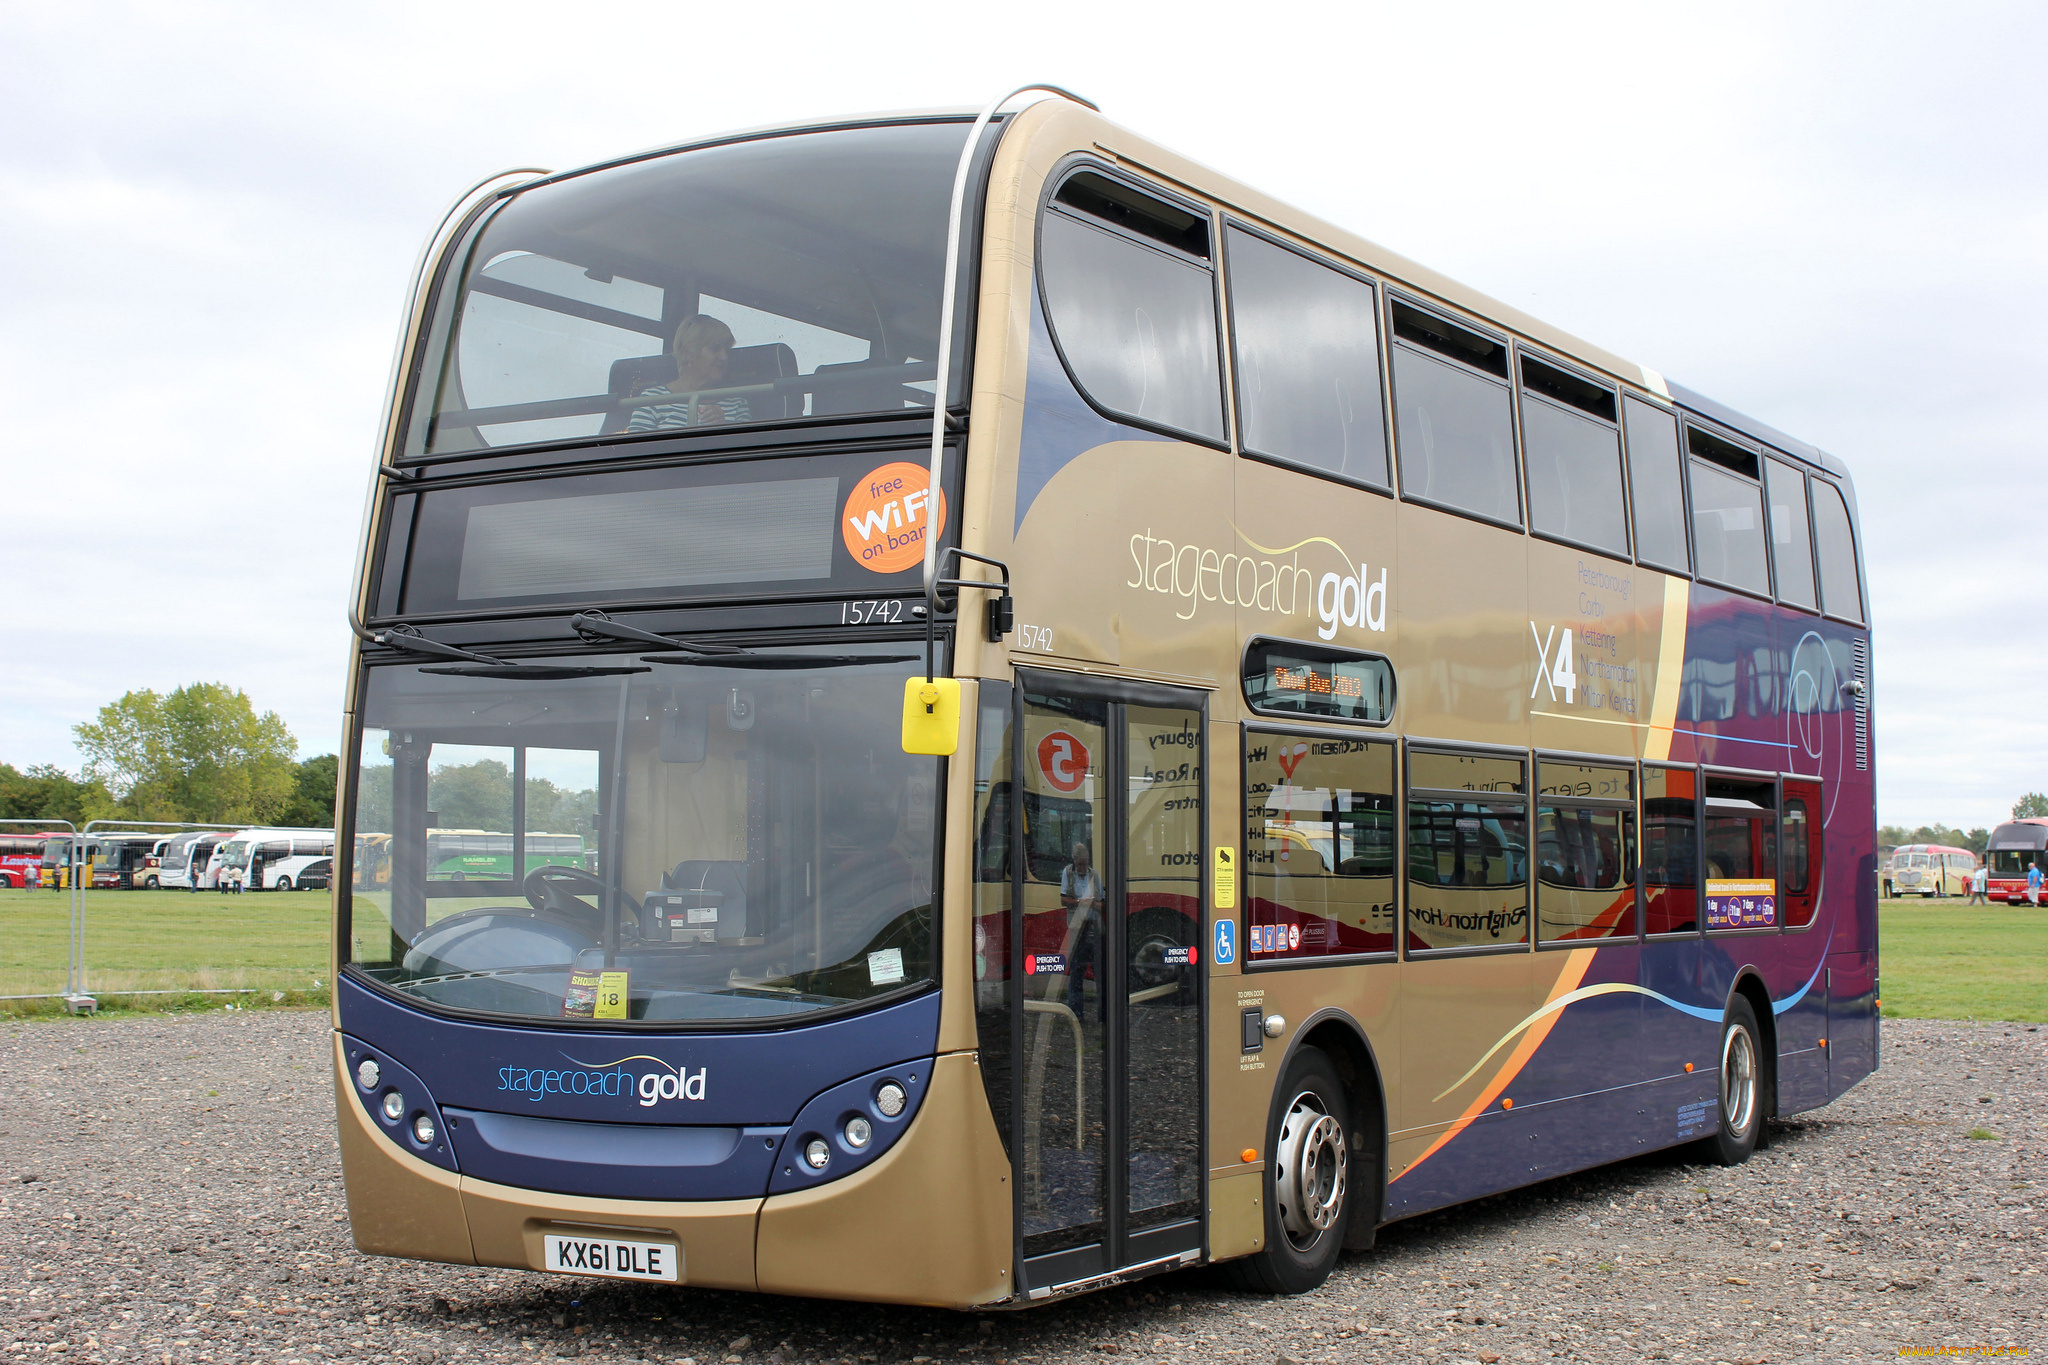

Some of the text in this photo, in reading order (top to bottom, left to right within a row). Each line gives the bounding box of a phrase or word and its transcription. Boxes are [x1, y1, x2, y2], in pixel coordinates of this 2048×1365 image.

[870, 478, 903, 499] free
[862, 526, 927, 560] on boar
[1127, 528, 1387, 640] stagecoach gold
[1577, 561, 1632, 600] Peterborough
[841, 599, 903, 625] 15742
[1579, 592, 1605, 620] Corby
[1017, 623, 1054, 652] 15742
[1579, 623, 1617, 657] Kettering
[1529, 620, 1577, 704] X4
[1580, 653, 1635, 687] Northampton
[1580, 684, 1635, 717] Milton Keynes
[1036, 956, 1060, 964] EMERGENCY
[602, 993, 618, 1006] 18
[498, 1064, 707, 1107] stagecoach gold
[558, 1241, 662, 1275] KX61 DLE
